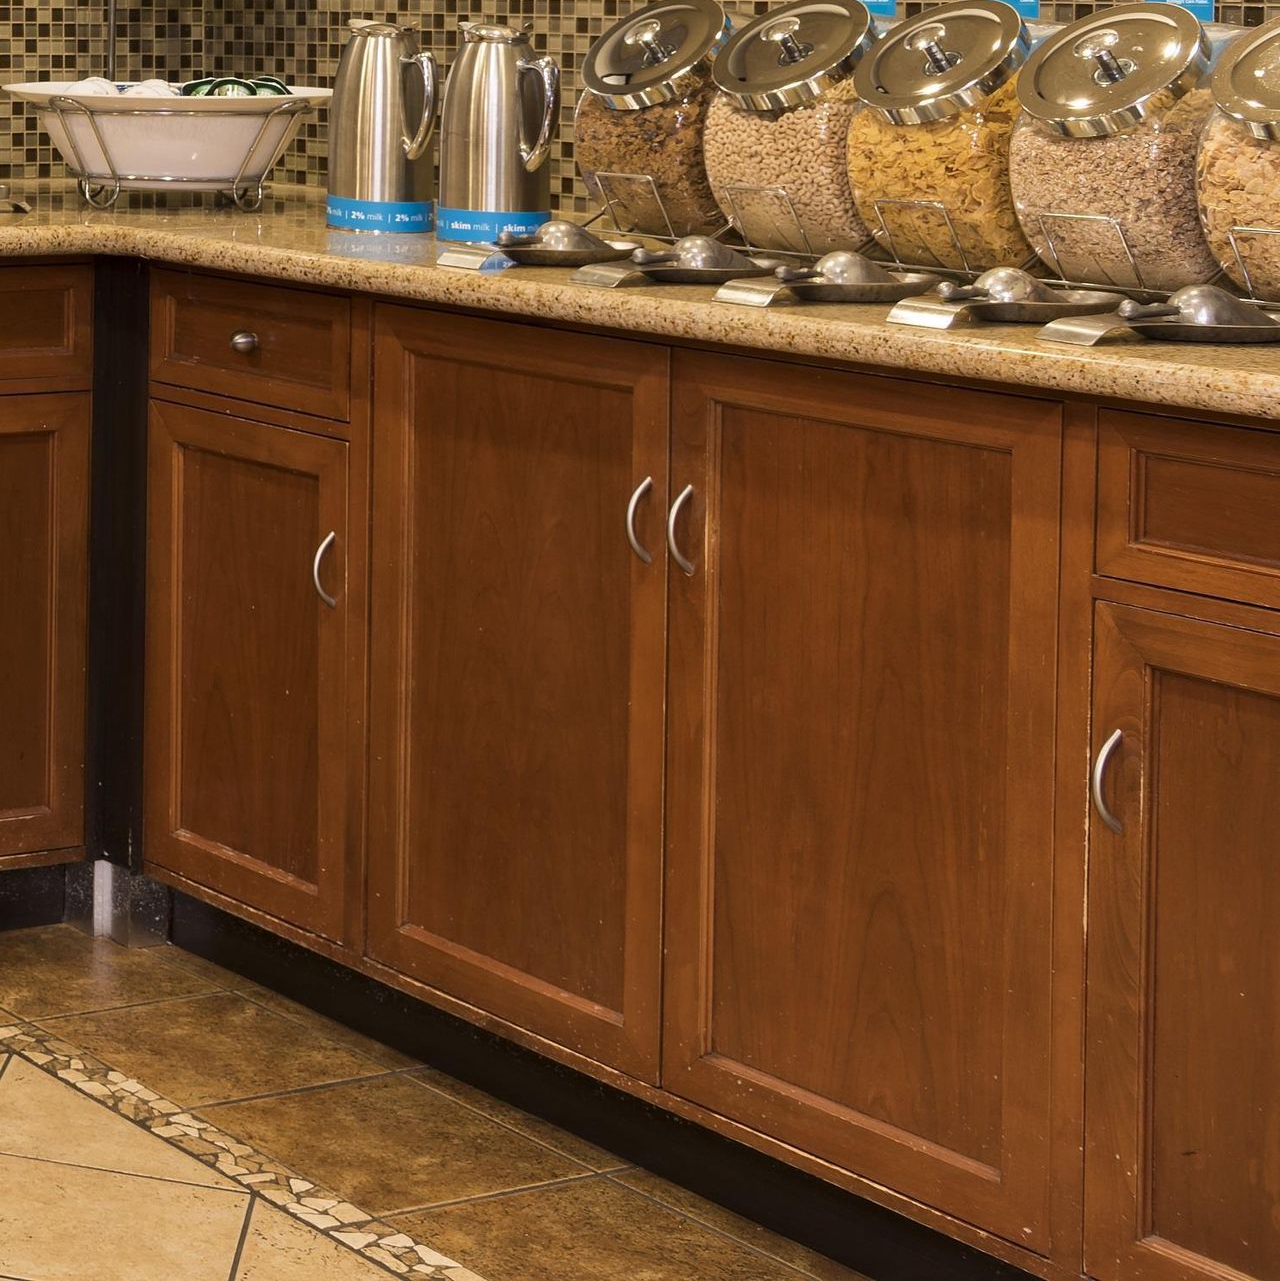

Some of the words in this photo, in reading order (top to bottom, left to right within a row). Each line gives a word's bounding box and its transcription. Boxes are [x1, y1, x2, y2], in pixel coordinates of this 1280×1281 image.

[350, 210, 366, 220] 2%
[367, 212, 384, 221] milk
[395, 213, 409, 222] 2%
[450, 221, 471, 231] skim
[472, 222, 491, 231] milk
[502, 223, 526, 233] skim
